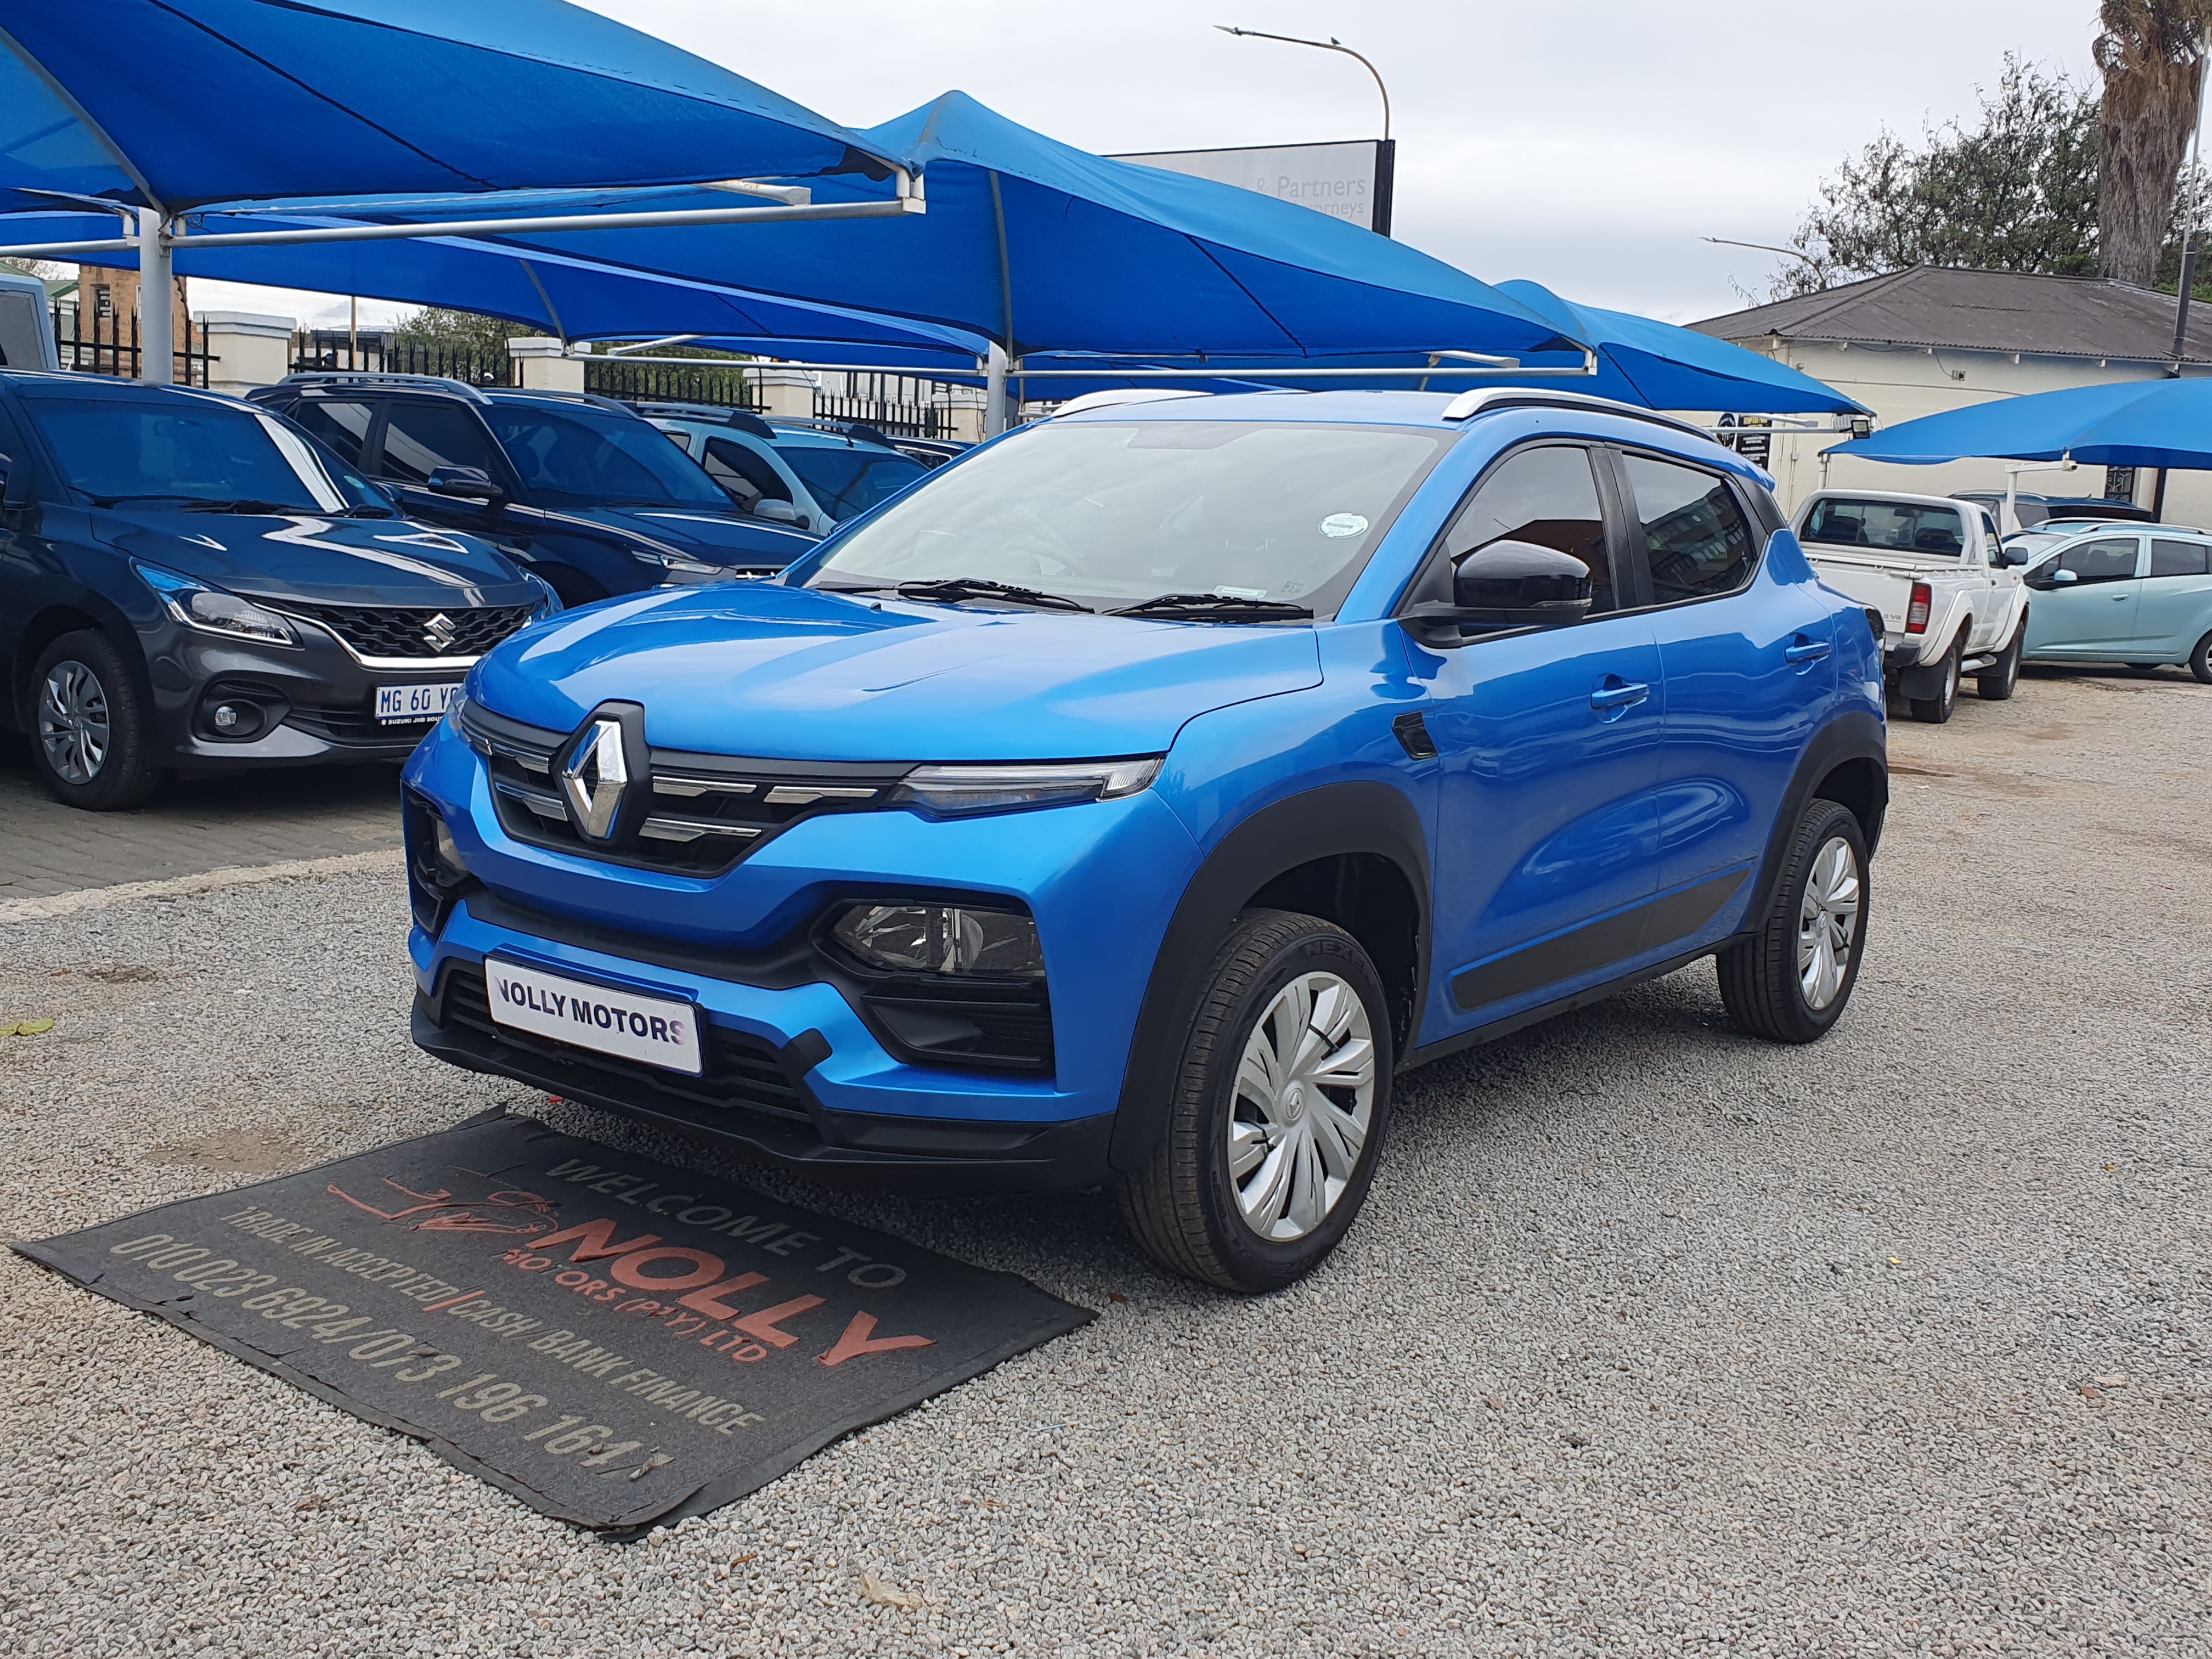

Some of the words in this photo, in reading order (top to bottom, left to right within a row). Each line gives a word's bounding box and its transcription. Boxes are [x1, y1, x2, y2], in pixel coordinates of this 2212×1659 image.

[1277, 176, 1365, 198] Partners
[1309, 202, 1364, 219] orneys
[381, 690, 402, 713] MG
[411, 688, 431, 711] 60
[494, 975, 566, 1017] NOLLY
[571, 997, 686, 1046] MOTORS
[544, 1158, 822, 1256] WELCOME
[815, 1245, 907, 1288] TO
[110, 1234, 211, 1269] 010
[173, 1259, 277, 1297] 023
[435, 1372, 549, 1423] 196
[287, 1234, 342, 1256] IN
[608, 1367, 767, 1438] FINANCE
[500, 1248, 627, 1301] MOORS
[699, 1329, 768, 1362] LTD
[524, 1217, 938, 1367] NOLLY
